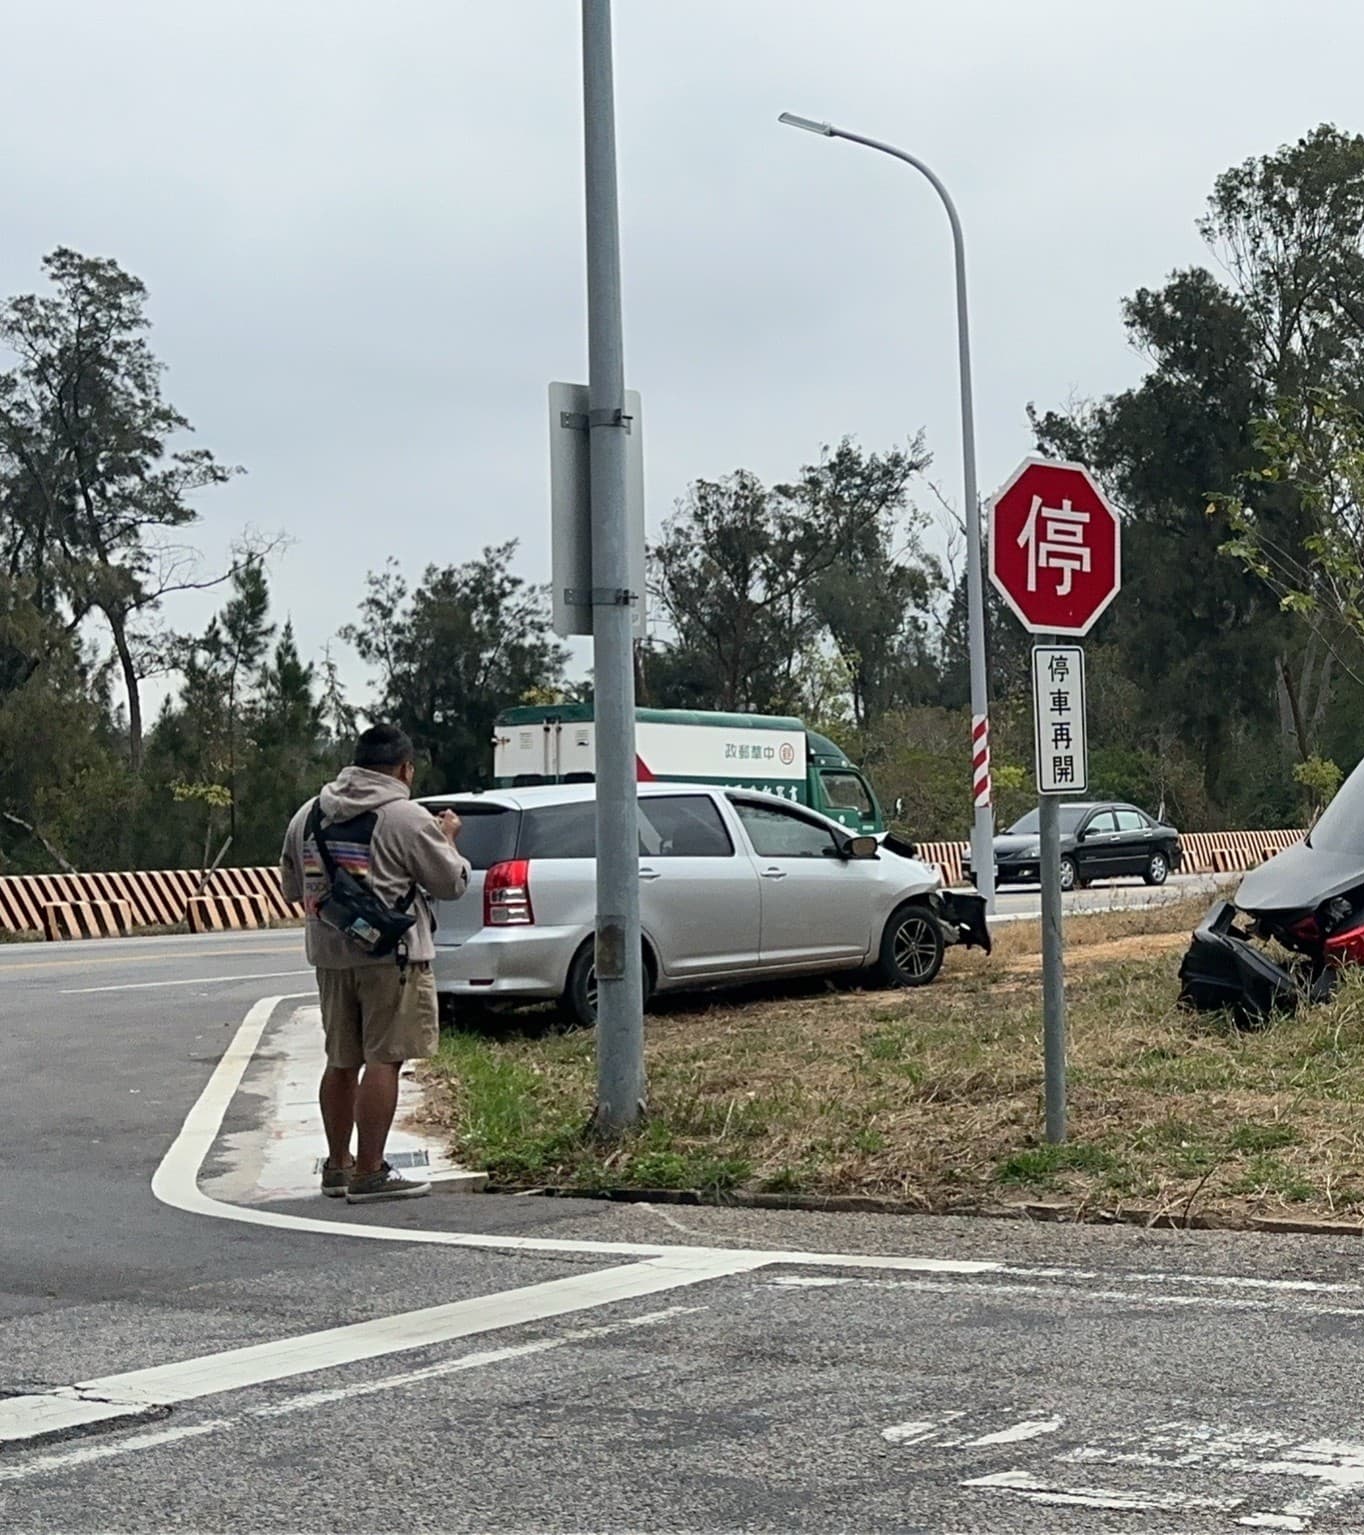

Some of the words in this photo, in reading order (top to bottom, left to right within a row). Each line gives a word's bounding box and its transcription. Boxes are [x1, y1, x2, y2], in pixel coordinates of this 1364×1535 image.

[1017, 494, 1091, 596] 停
[1047, 654, 1075, 785] 停車再開
